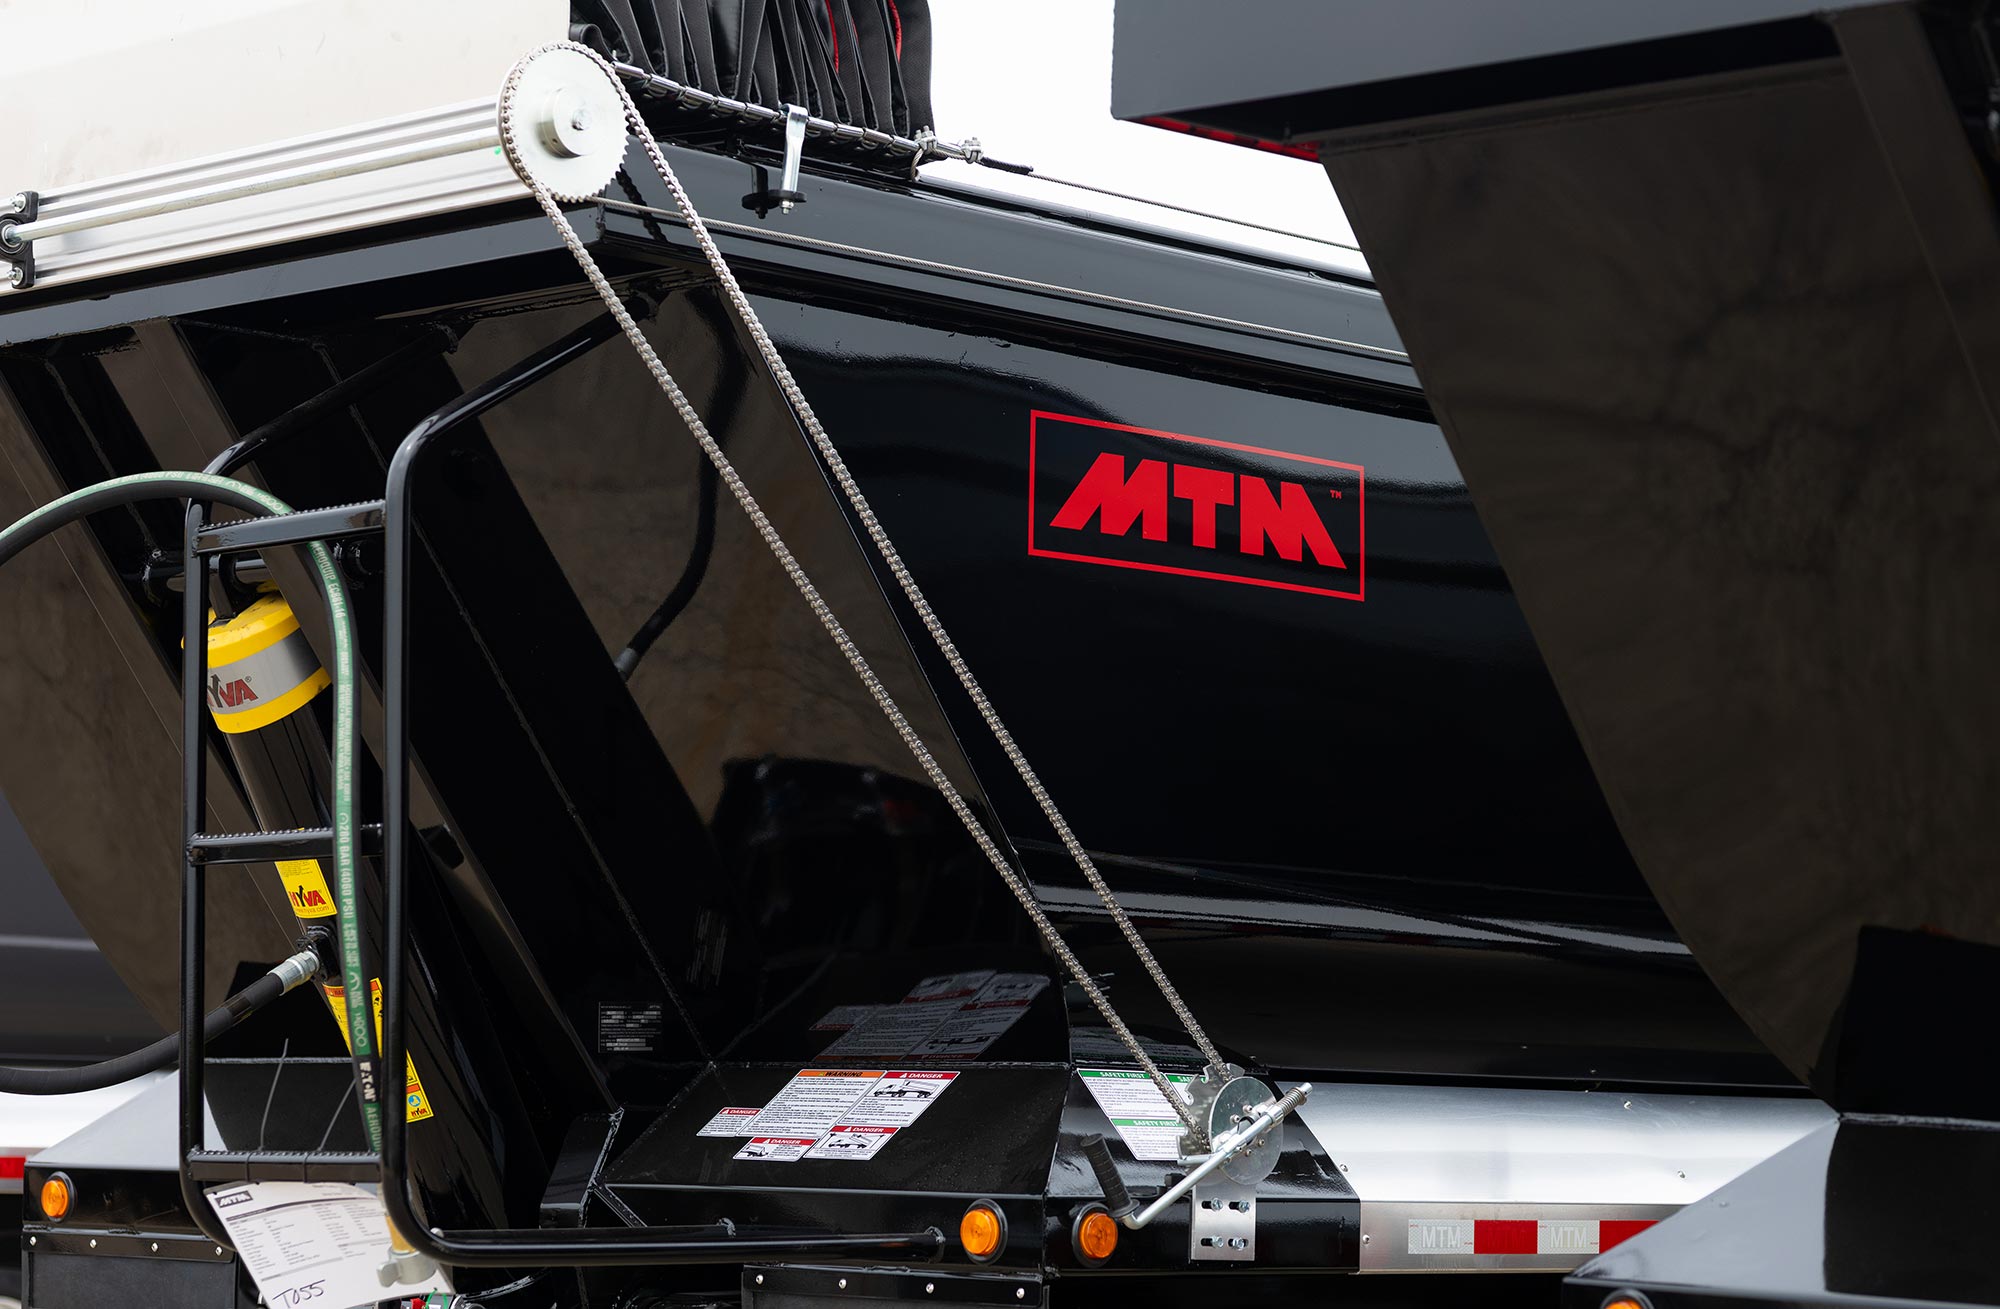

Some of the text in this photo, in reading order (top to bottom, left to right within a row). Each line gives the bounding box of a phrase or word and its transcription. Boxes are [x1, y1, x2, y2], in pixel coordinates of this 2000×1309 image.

[1050, 452, 1347, 569] MTM
[310, 541, 336, 580] AEROQUIP
[207, 674, 259, 708] YVA
[339, 846, 351, 866] BAR
[288, 884, 327, 907] HYVA
[360, 1061, 377, 1100] EATON
[1422, 1226, 1461, 1248] MTM
[1551, 1226, 1587, 1248] MTM
